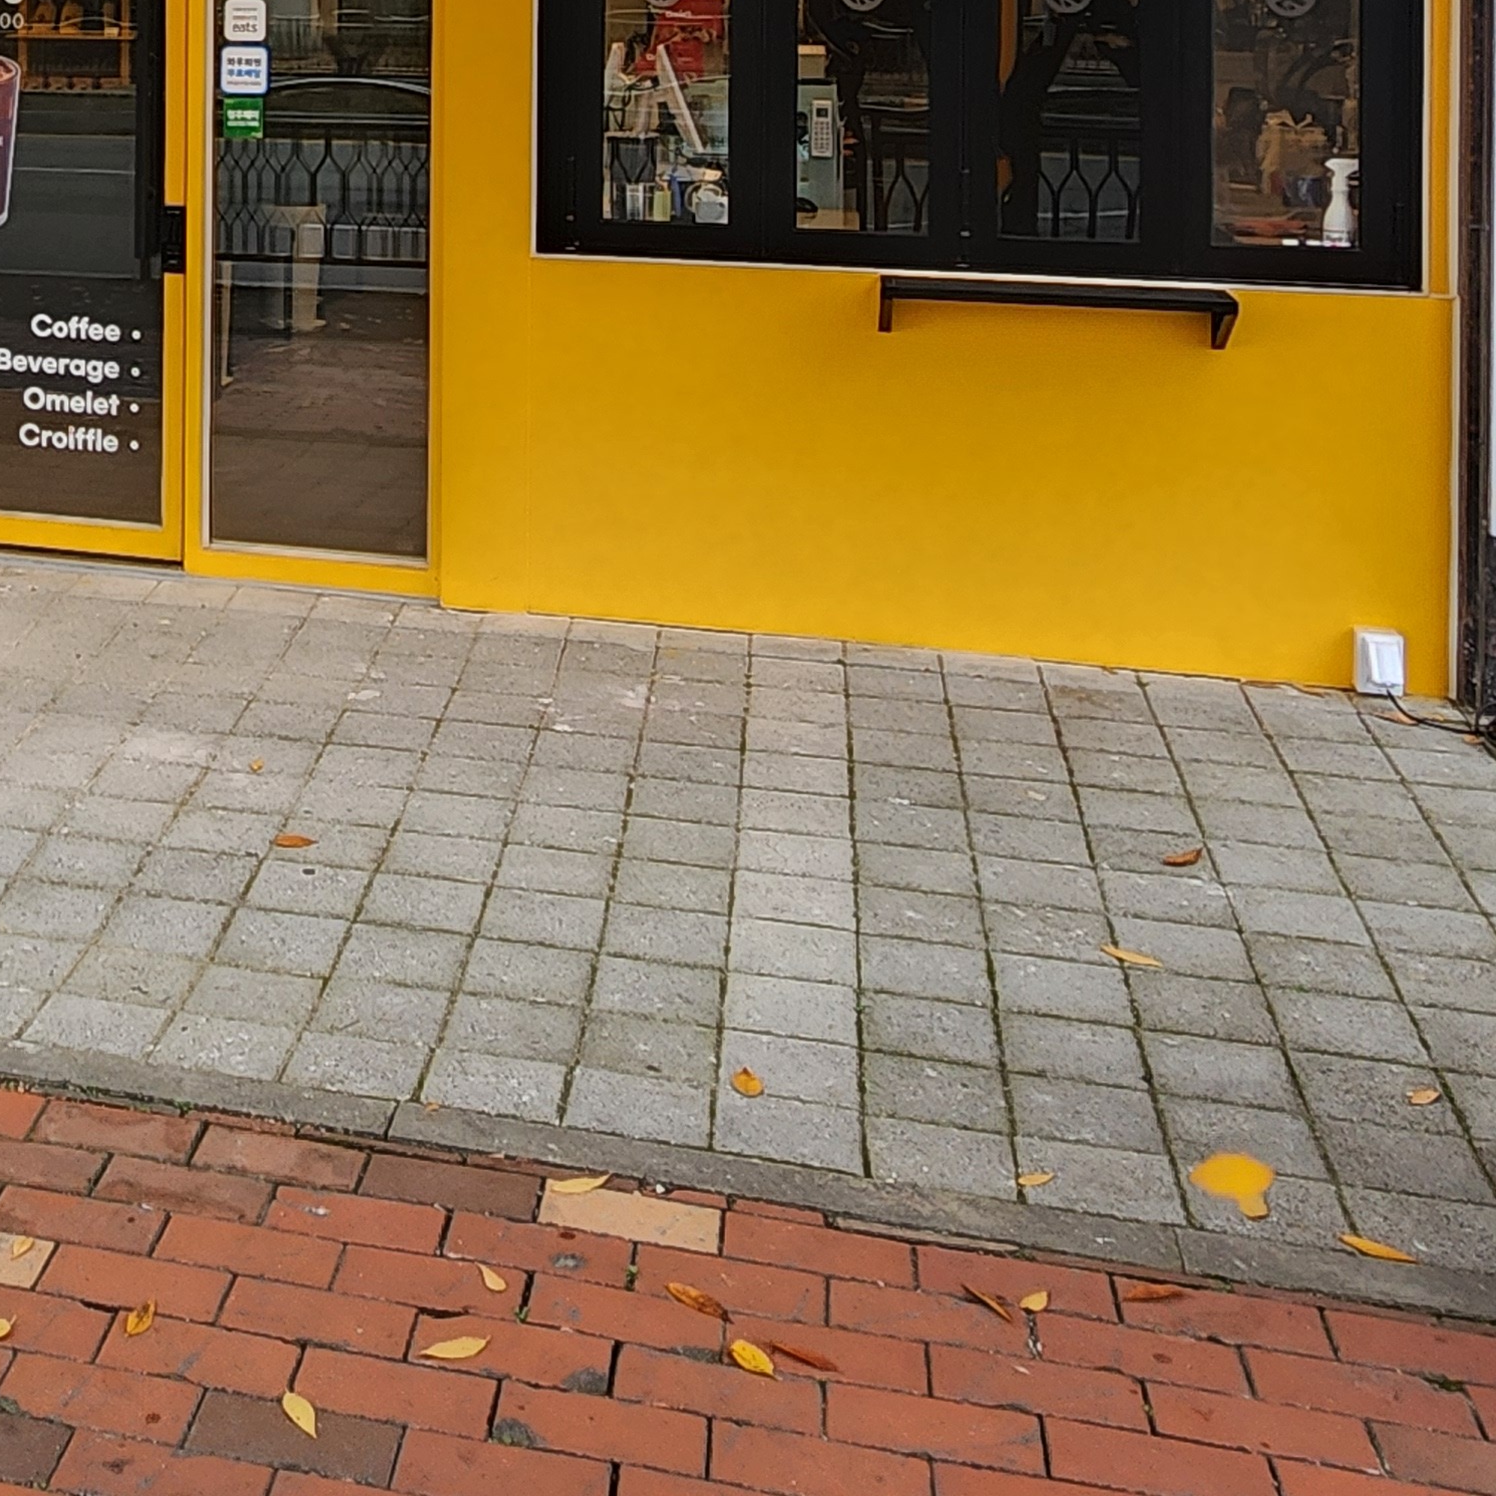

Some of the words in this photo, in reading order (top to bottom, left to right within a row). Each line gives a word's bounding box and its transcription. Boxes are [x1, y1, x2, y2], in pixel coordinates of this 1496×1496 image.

[232, 22, 258, 33] eats
[30, 313, 121, 342] Coffee
[23, 386, 120, 416] Omelet
[19, 423, 119, 453] Croiffle
